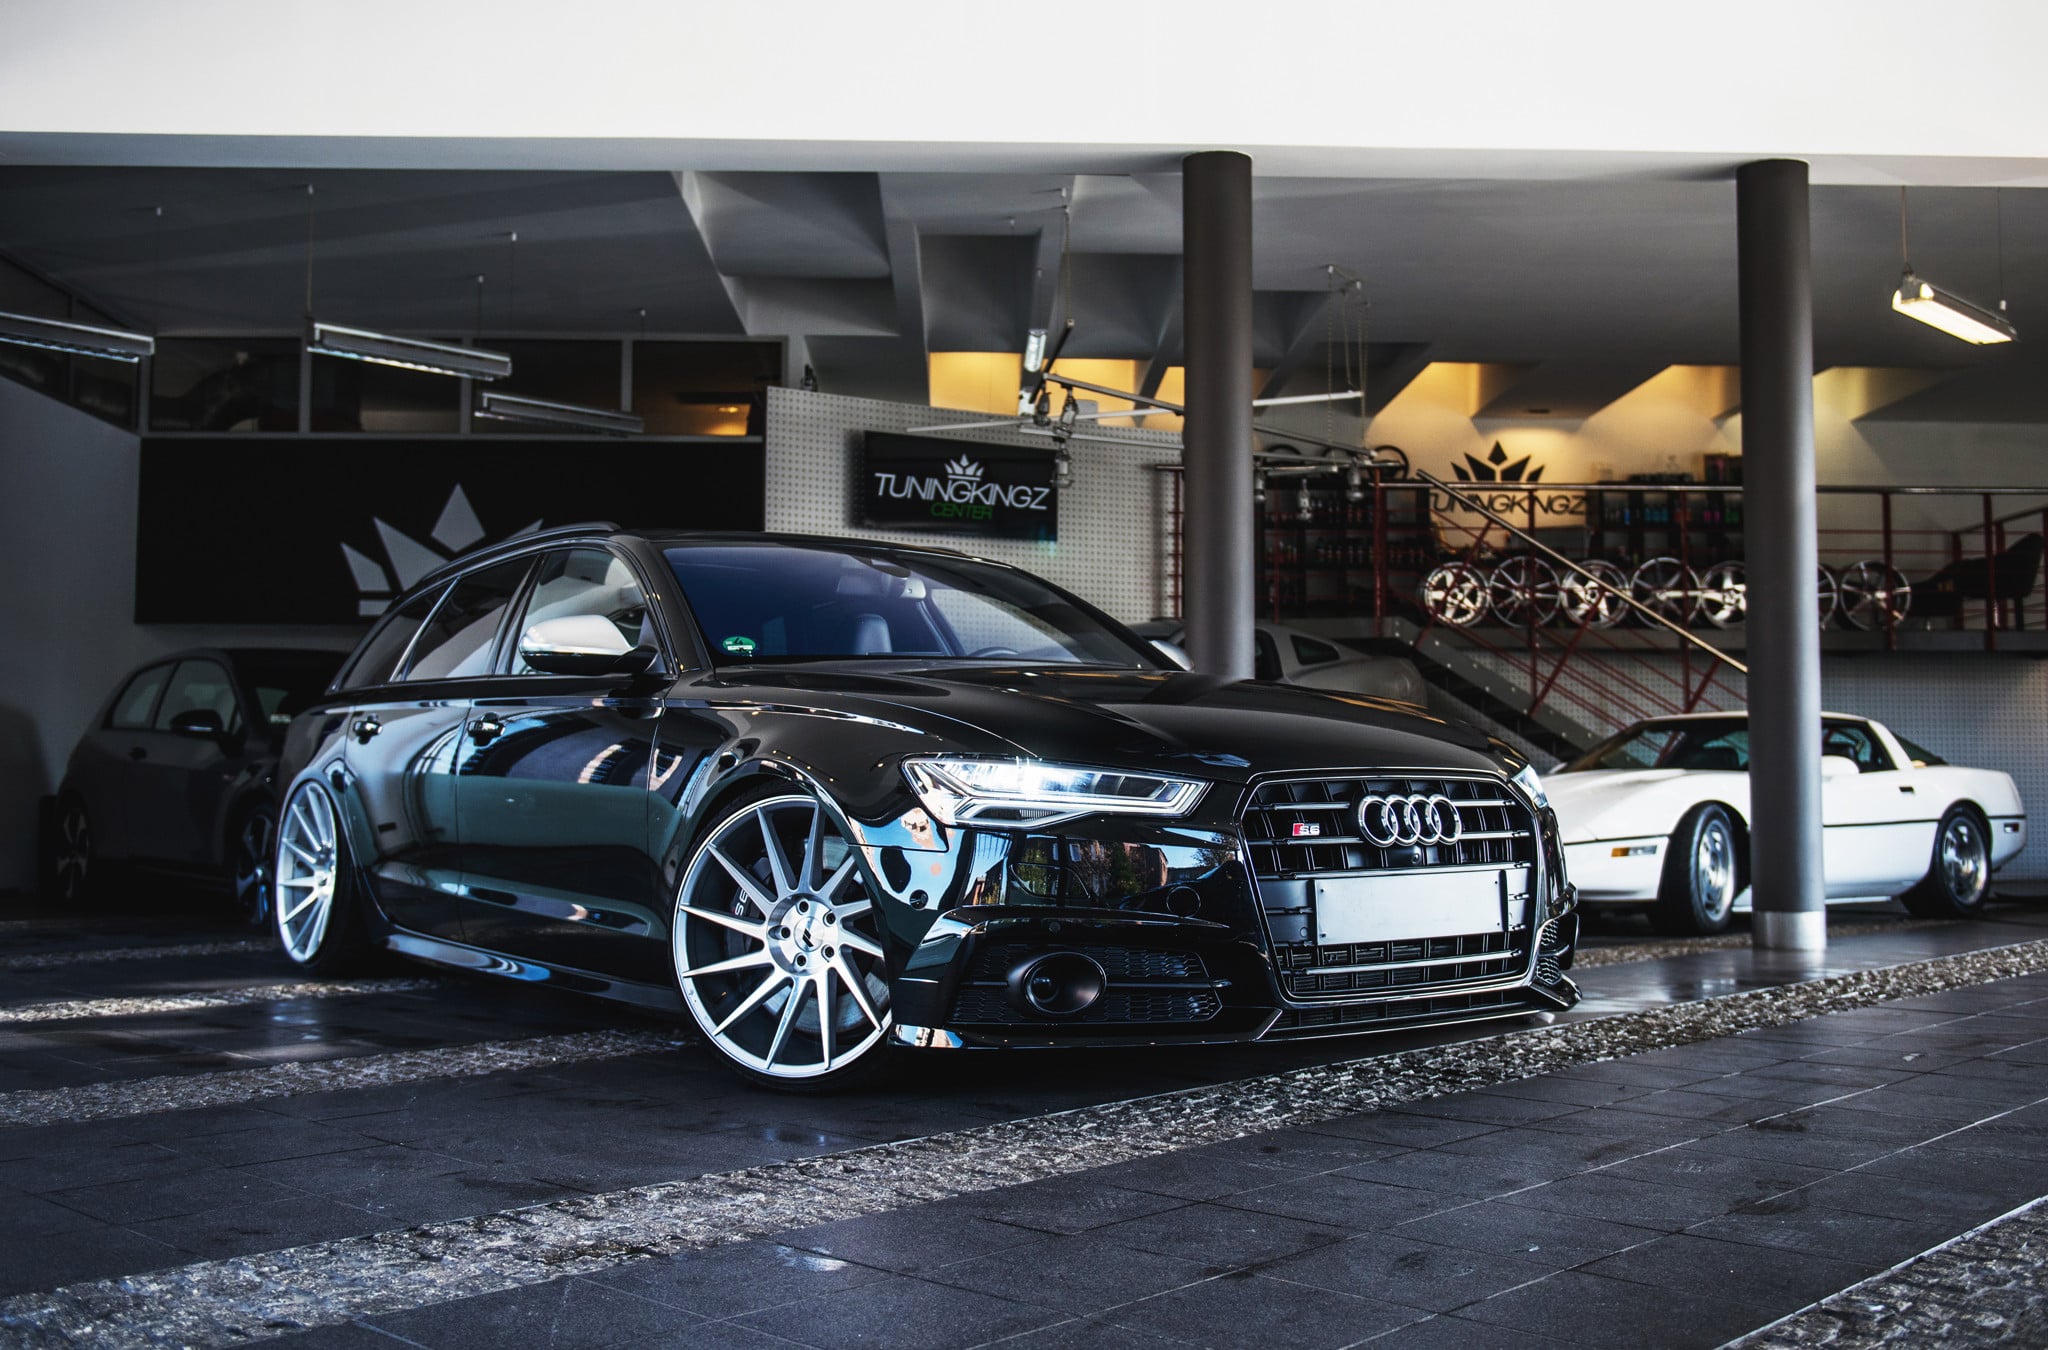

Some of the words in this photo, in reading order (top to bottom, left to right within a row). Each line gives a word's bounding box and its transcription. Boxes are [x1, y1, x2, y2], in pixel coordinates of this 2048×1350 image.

[874, 472, 1050, 510] TUNINGKINGZ
[930, 502, 993, 520] CENTER
[1430, 493, 1584, 515] UNINGKNGZ
[1299, 824, 1320, 836] S6
